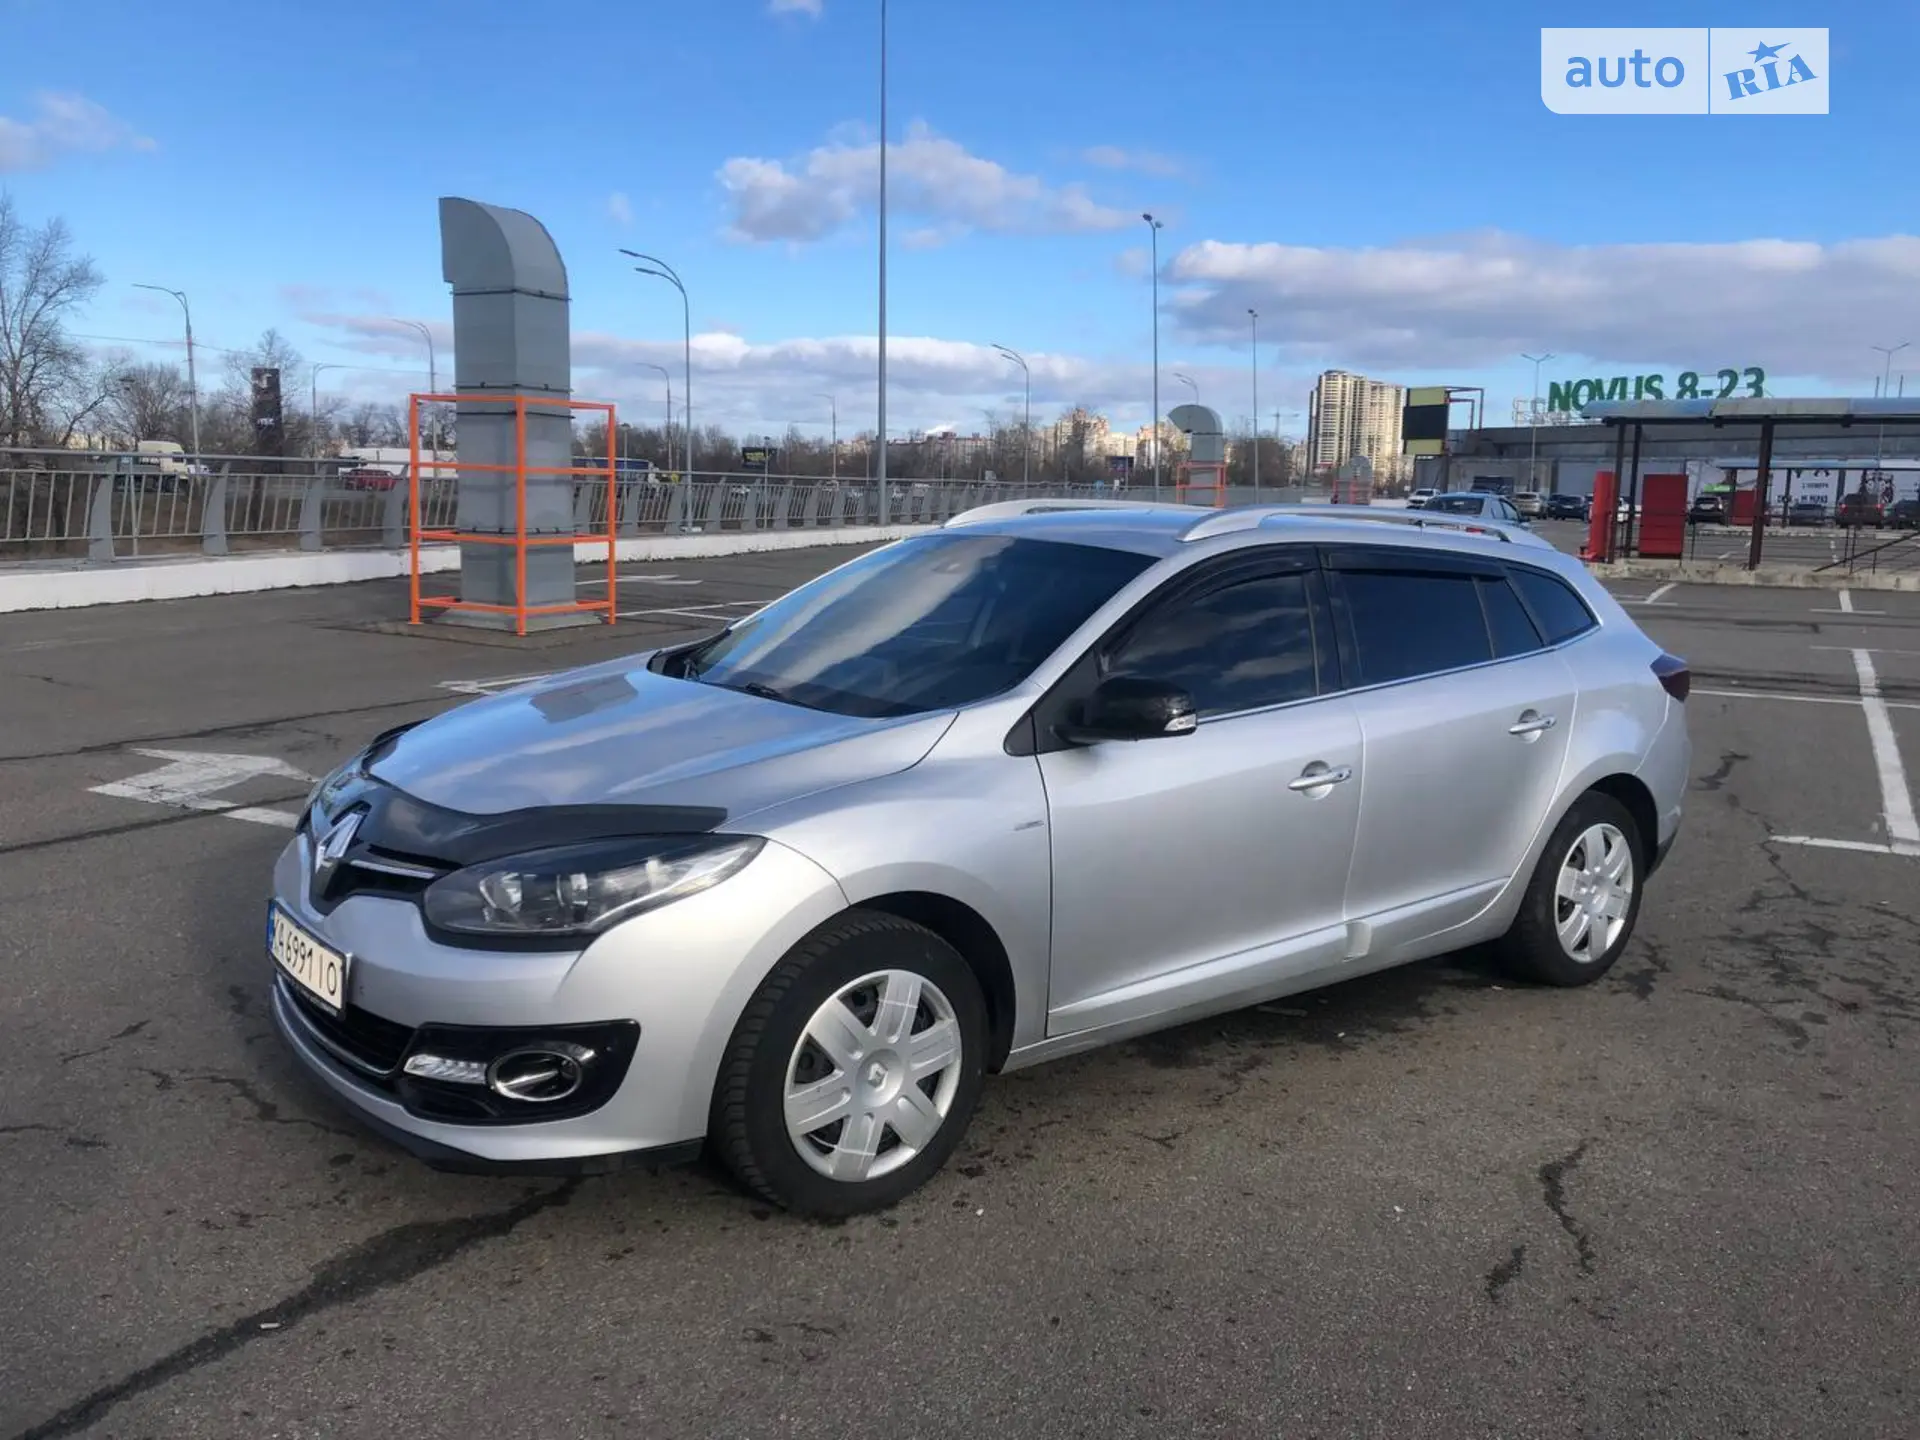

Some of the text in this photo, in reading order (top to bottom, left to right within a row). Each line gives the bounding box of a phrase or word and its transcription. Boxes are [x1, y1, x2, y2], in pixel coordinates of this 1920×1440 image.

[1548, 374, 1664, 411] NOVUS
[1677, 367, 1765, 399] 8-23
[286, 931, 313, 981] 6991
